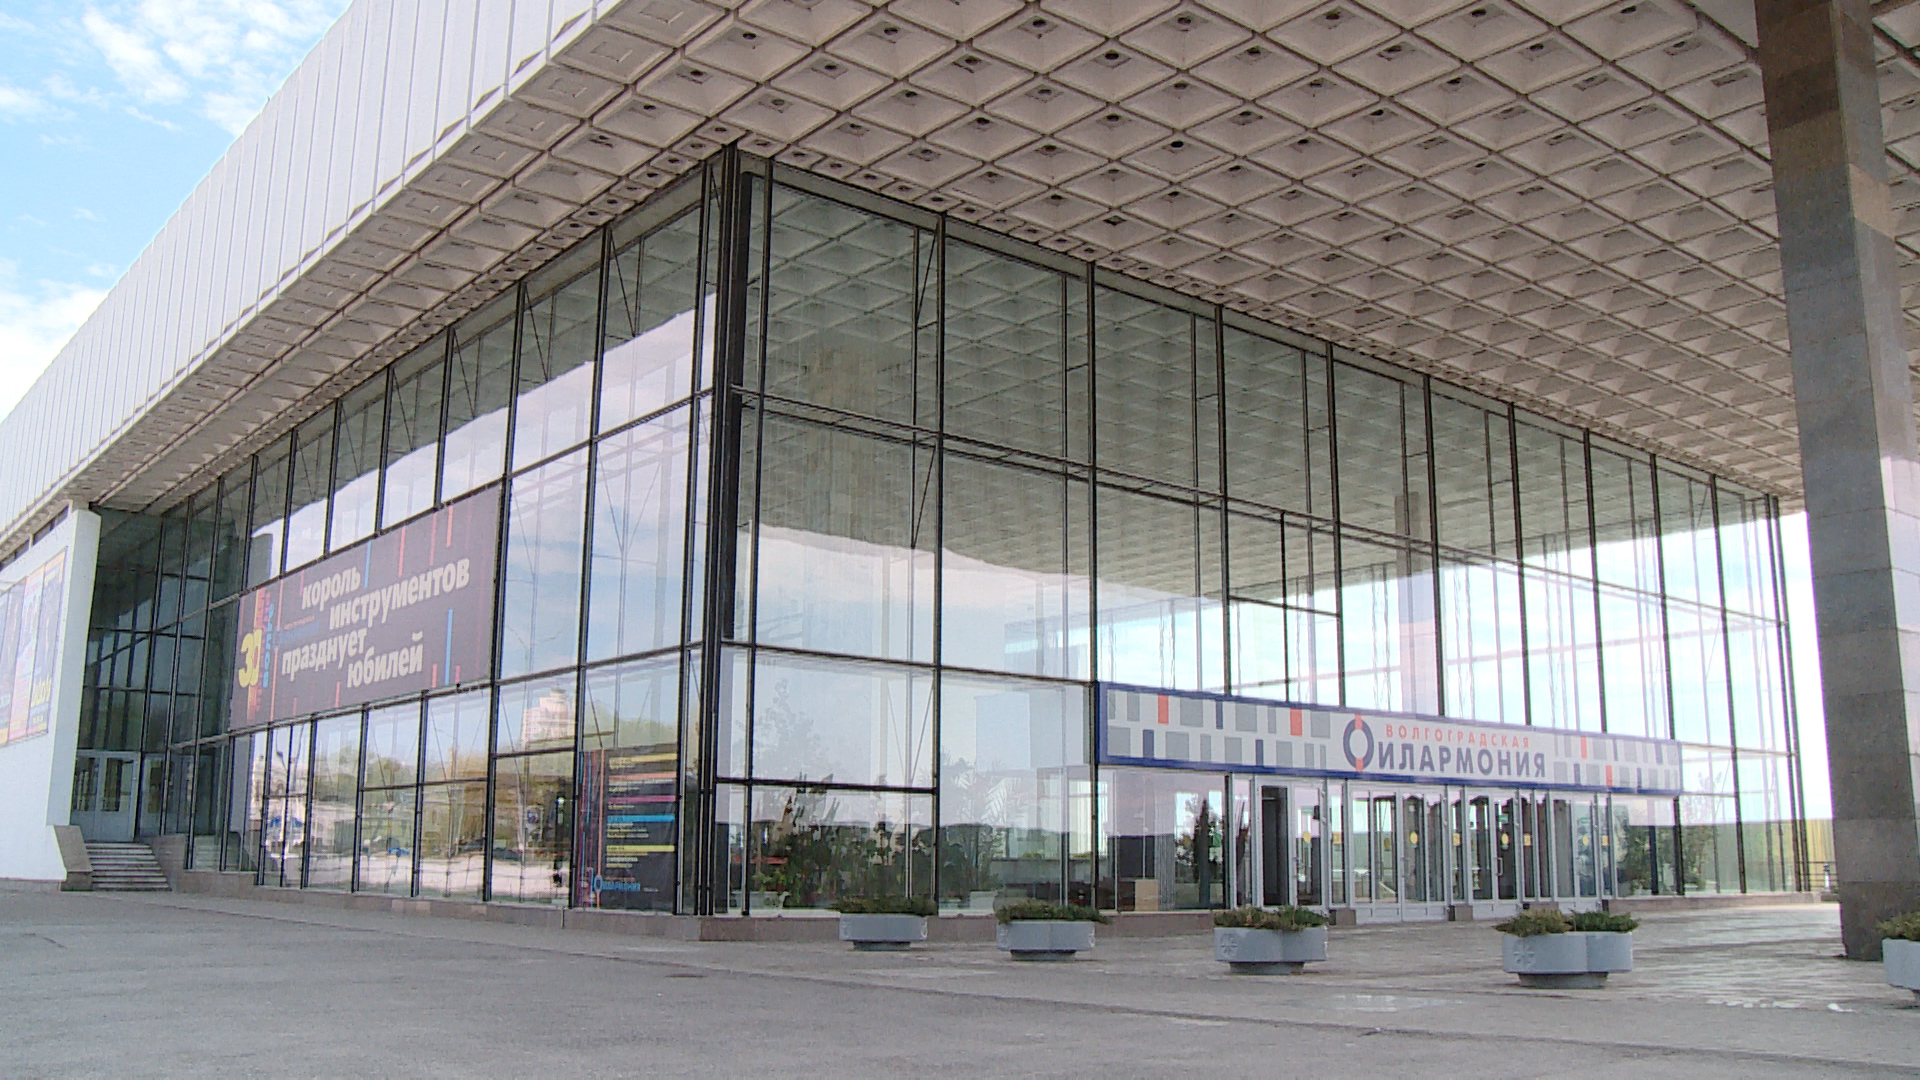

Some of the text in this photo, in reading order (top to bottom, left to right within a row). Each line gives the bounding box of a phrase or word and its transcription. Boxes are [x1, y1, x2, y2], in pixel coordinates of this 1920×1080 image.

[301, 566, 361, 611] король
[329, 557, 470, 631] инструментов
[281, 627, 368, 682] празднует
[346, 630, 424, 688] юбилей
[1385, 723, 1530, 749] ВОЛГОГРАДСКАЯ
